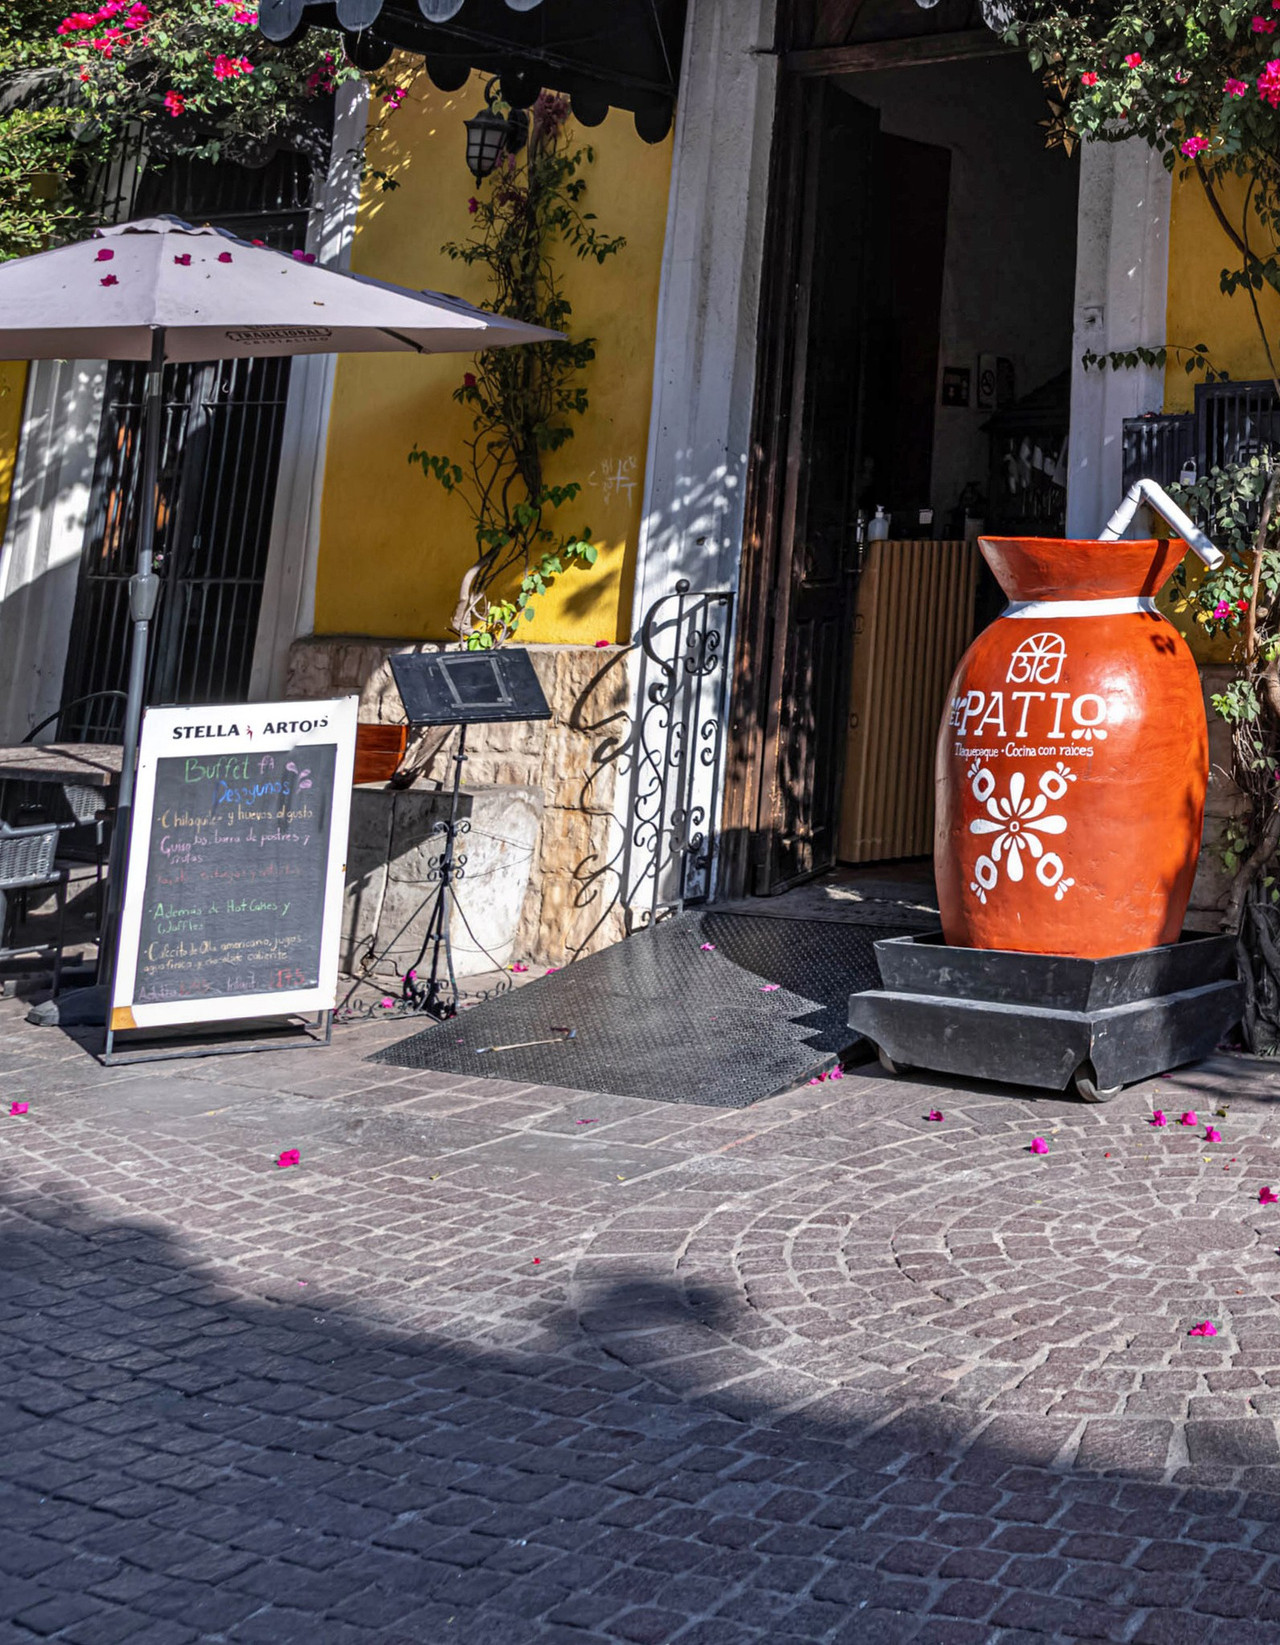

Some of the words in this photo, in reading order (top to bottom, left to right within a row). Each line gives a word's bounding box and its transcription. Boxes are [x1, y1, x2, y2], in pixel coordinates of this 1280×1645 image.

[239, 329, 321, 338] TRADICIONAL
[243, 337, 329, 346] CRISTALINO
[957, 690, 1107, 740] PATIO
[172, 724, 240, 740] STELLA
[954, 742, 999, 761] Tlaquepaque
[1006, 742, 1036, 757] Cocina
[1038, 745, 1056, 756] con
[185, 755, 250, 783] Buffet
[229, 812, 234, 826] y
[238, 804, 272, 820] huevos
[287, 805, 313, 823] gusto
[261, 827, 299, 847] postres
[226, 900, 247, 913] Hot
[282, 902, 291, 916] y
